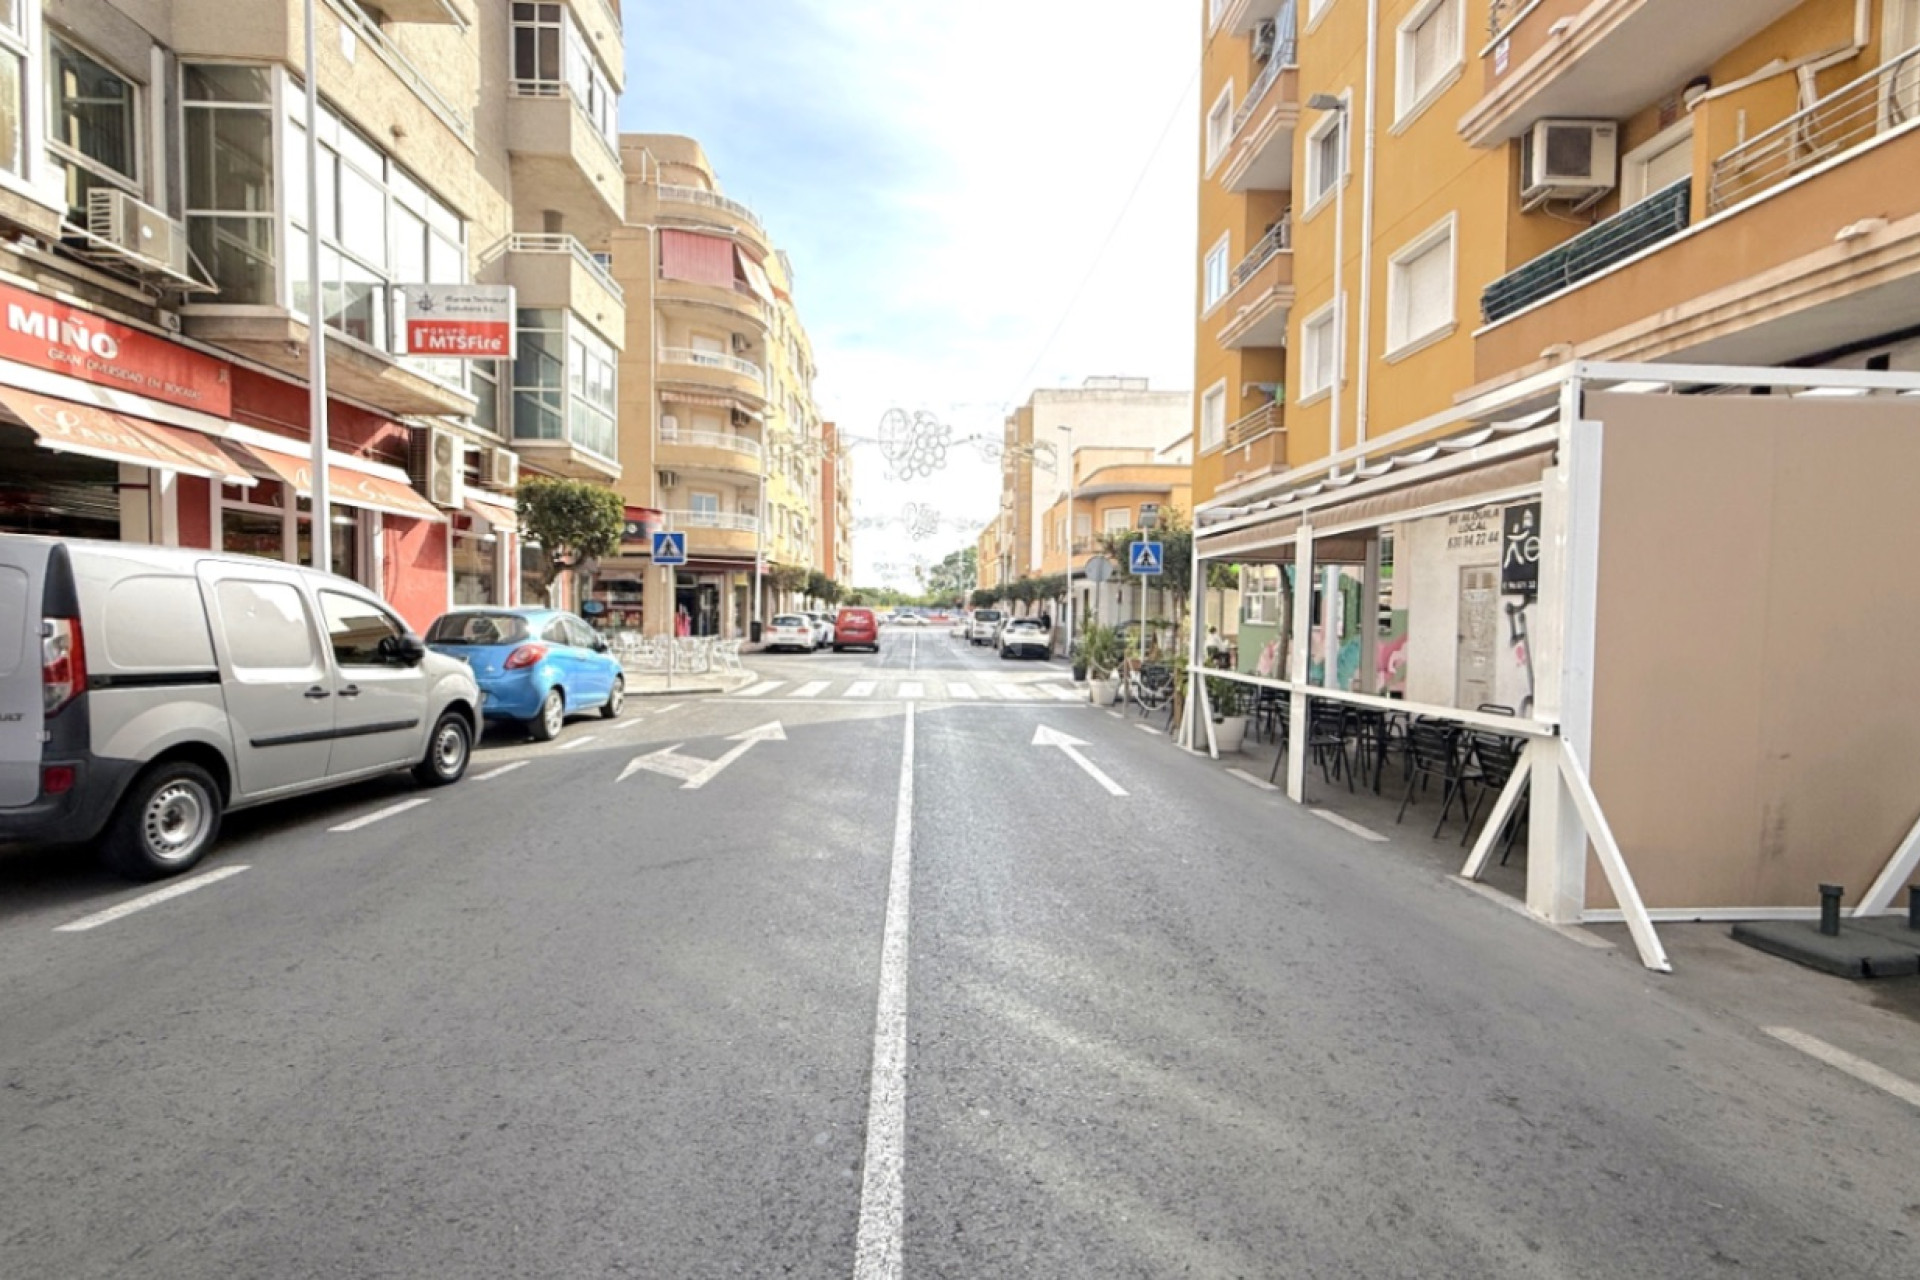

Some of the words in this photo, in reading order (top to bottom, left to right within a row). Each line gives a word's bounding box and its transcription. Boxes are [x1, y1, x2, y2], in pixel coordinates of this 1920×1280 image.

[8, 303, 118, 359] MIÑO
[428, 335, 502, 350] MTSFire
[47, 347, 83, 367] GRAN
[86, 359, 144, 385] DIVERSIDAD
[1458, 521, 1486, 533] LOCAL
[1475, 532, 1486, 546] 22
